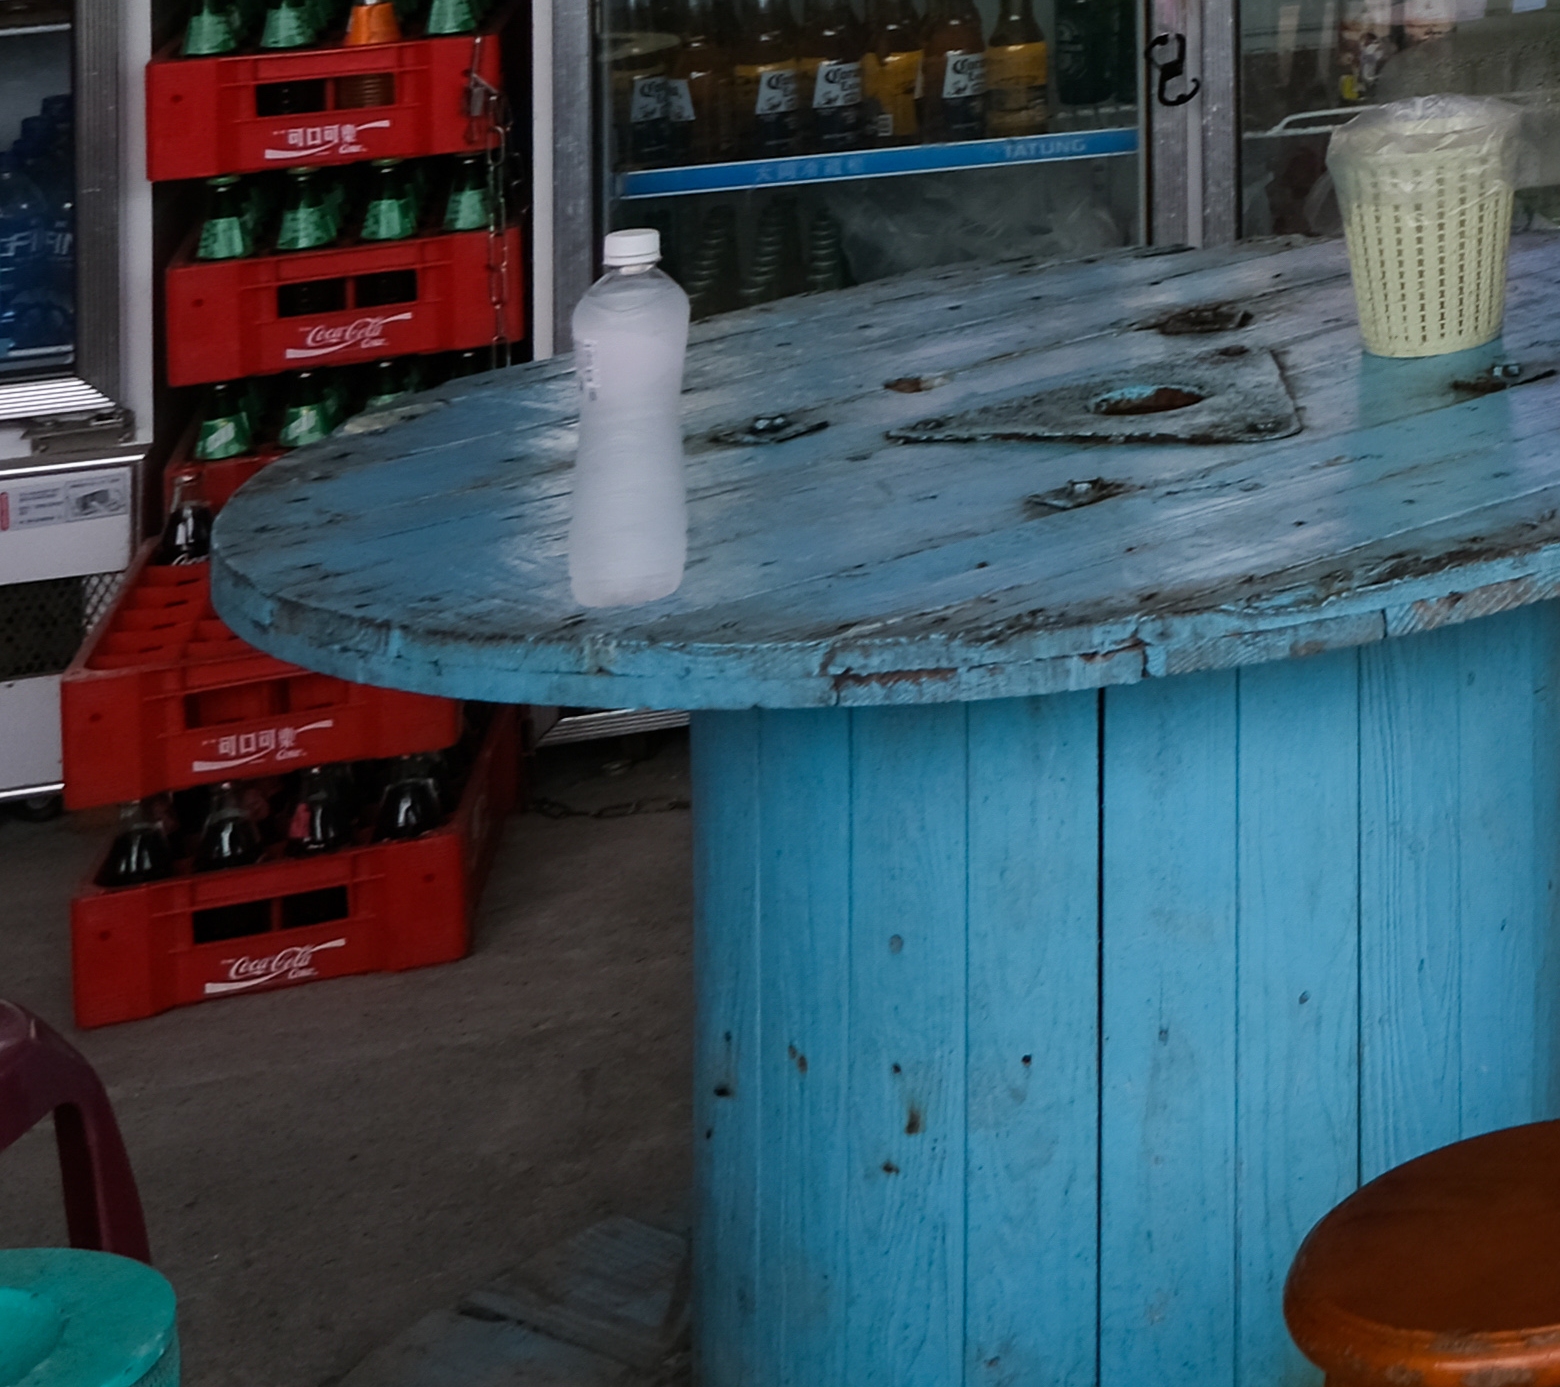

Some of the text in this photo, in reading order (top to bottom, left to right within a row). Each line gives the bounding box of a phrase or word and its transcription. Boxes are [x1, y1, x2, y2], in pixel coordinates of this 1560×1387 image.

[288, 124, 357, 147] 可口可樂
[1003, 137, 1088, 161] TATUNG
[218, 727, 298, 757] 可口可樂
